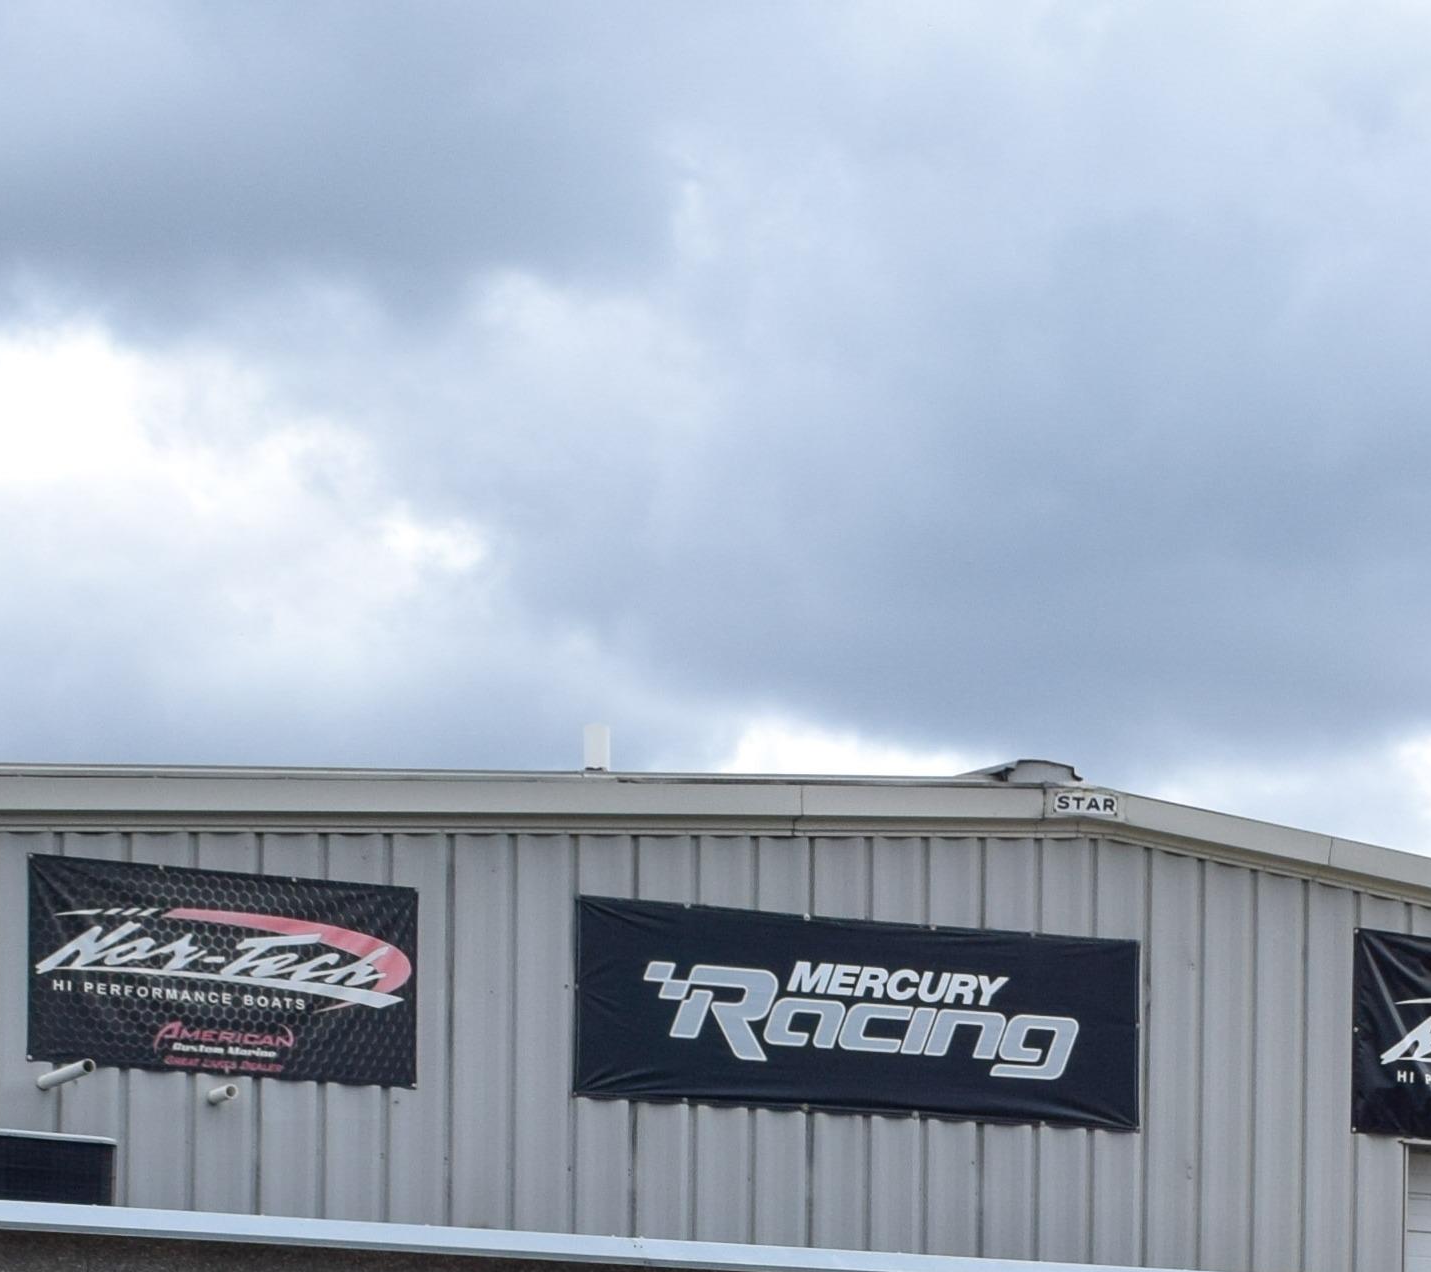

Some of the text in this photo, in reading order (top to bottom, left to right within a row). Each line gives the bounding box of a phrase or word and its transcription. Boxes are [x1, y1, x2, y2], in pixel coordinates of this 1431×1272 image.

[1056, 795, 1116, 812] STAR
[52, 979, 306, 1011] HI PERFORMANCE BOATS
[786, 960, 1010, 1007] MERCURY
[153, 1020, 295, 1053] AMERICAN
[643, 960, 1080, 1081] Racing
[1396, 1069, 1416, 1085] HI
